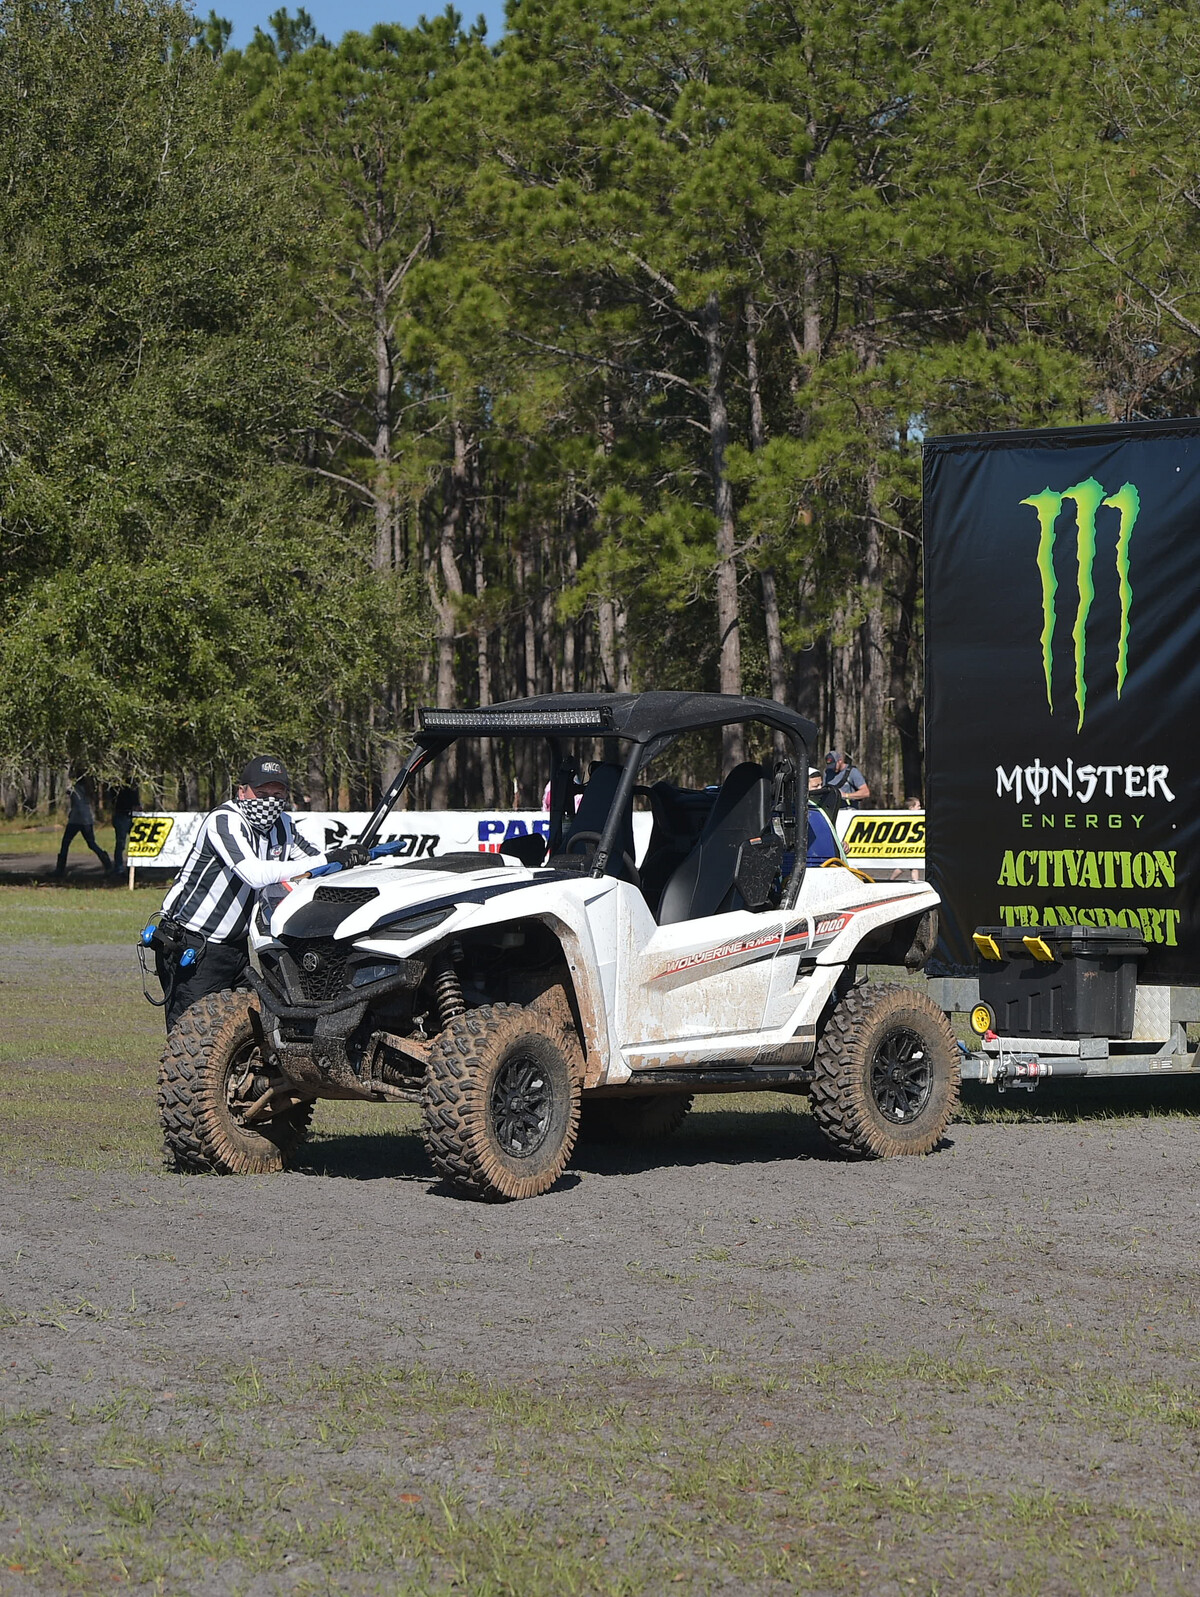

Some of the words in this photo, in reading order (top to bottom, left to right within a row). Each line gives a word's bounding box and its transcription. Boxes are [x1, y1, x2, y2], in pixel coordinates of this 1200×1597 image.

[996, 757, 1176, 806] MONSTER
[849, 821, 925, 843] MOOS
[1021, 813, 1145, 829] ENERGY
[997, 849, 1177, 888] ACTIVATION
[666, 941, 744, 971] WOLVERINE
[816, 918, 846, 935] 1000
